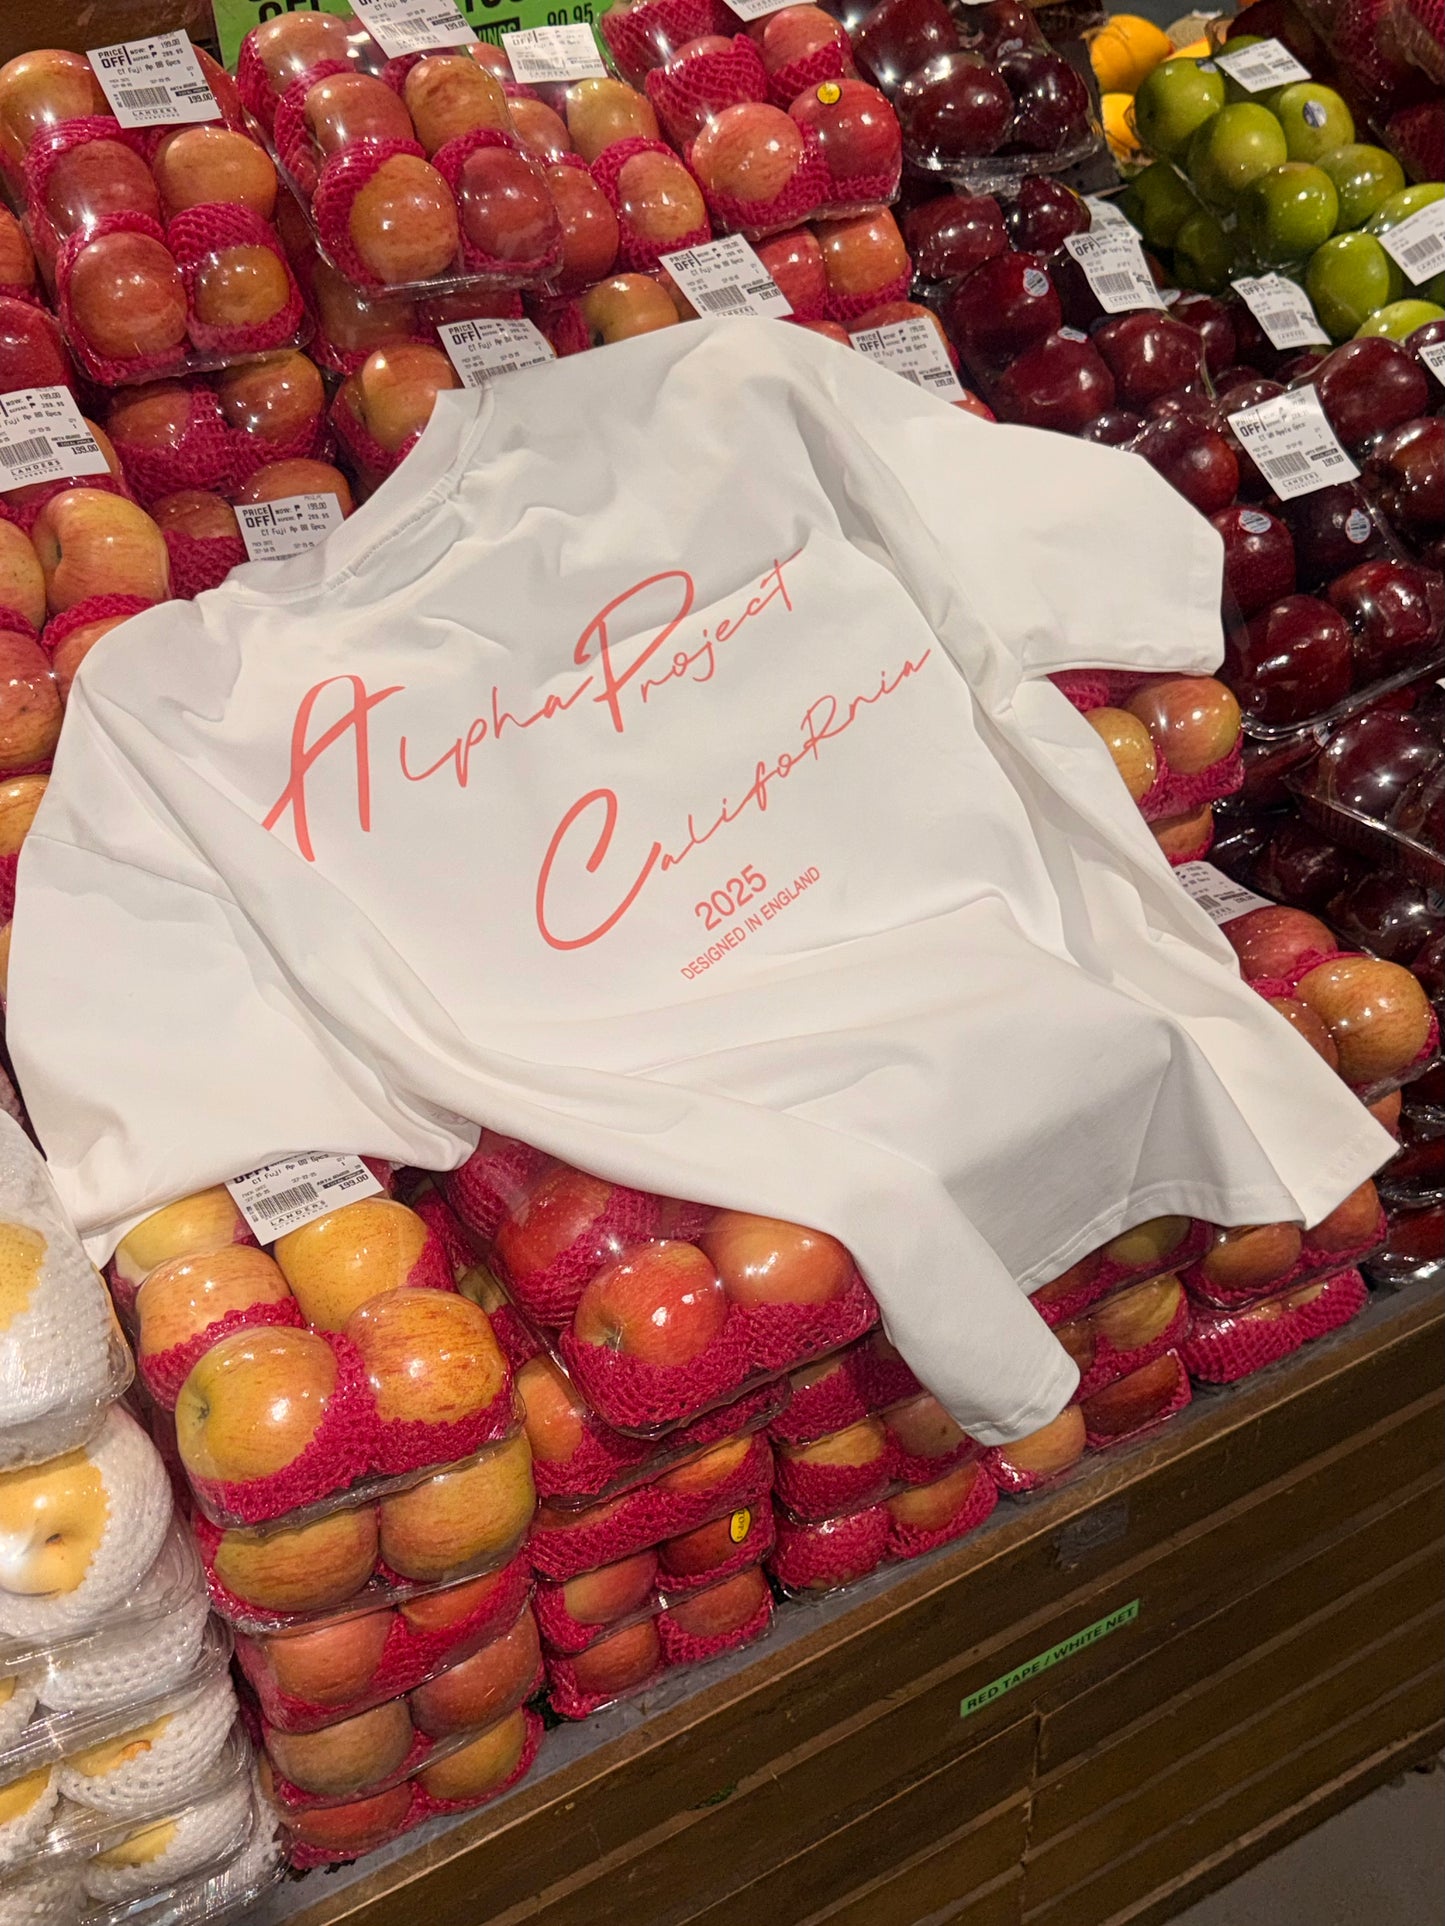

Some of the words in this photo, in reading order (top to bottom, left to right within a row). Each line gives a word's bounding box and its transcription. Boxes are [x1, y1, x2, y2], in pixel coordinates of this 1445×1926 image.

[98, 48, 124, 58] PRICE
[100, 56, 126, 68] OFF
[673, 259, 696, 271] OFF
[448, 324, 473, 334] PRICE
[452, 331, 476, 346] OFF
[855, 332, 877, 342] PRICE
[860, 340, 881, 352] OFF
[1239, 421, 1260, 438] OFF
[71, 444, 99, 455] 199.00
[11, 460, 61, 476] LANDERS
[242, 506, 269, 517] PRICE
[245, 515, 271, 529] OFF
[271, 527, 287, 537] Fuji
[694, 864, 767, 931] 2025
[680, 926, 747, 980] DESIGNED
[744, 913, 763, 933] IN
[759, 866, 821, 921] ENGLAND
[264, 1169, 282, 1179] Fuji
[338, 1173, 369, 1191] 199.00
[270, 1200, 326, 1226] LANDERS
[967, 1686, 999, 1710] RED
[1002, 1664, 1041, 1688] TAPE
[1043, 1656, 1051, 1666] /
[1053, 1624, 1102, 1659] WHITE
[1105, 1606, 1135, 1631] NET
